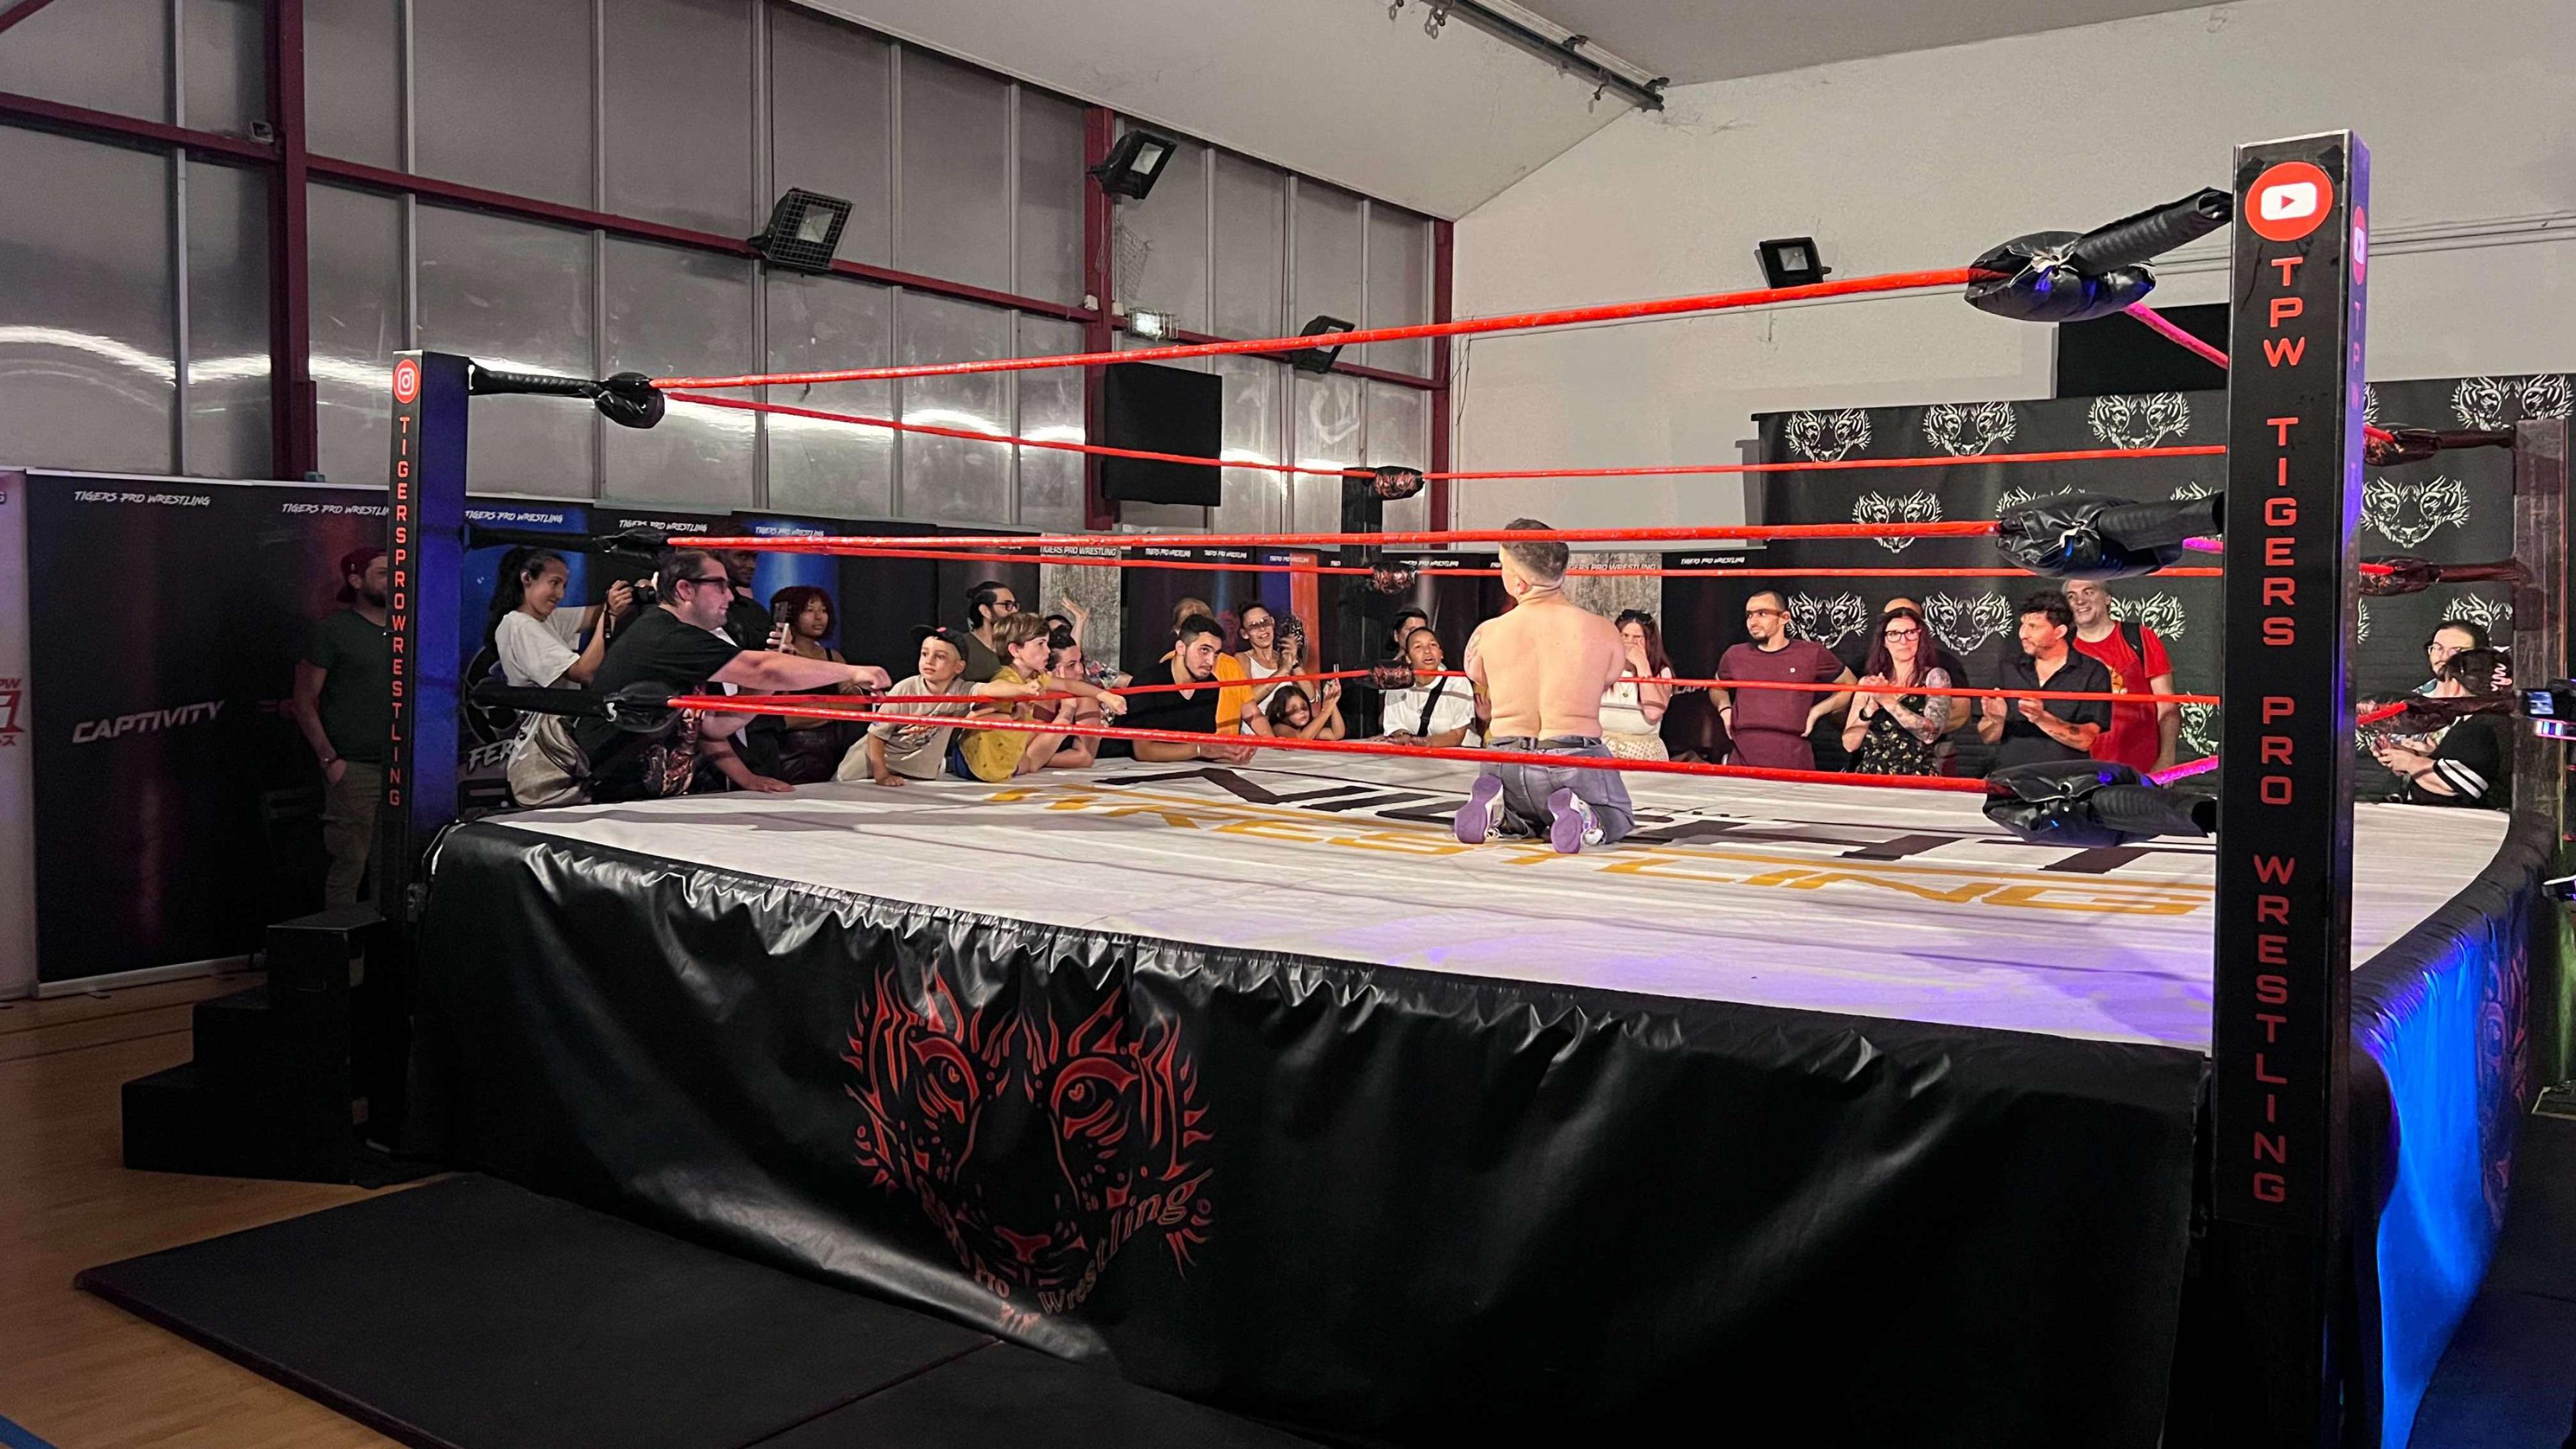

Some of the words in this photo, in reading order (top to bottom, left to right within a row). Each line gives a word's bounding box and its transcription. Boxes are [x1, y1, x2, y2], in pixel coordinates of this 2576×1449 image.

[2263, 256, 2305, 368] TPW
[74, 491, 117, 502] TIGERS
[120, 493, 145, 503] PRO
[148, 494, 211, 506] WRESTLING
[282, 503, 319, 514] TIGERS
[321, 504, 343, 514] PRO
[345, 506, 389, 516] WRESTLI
[517, 513, 564, 523] WRESTLING
[2263, 417, 2299, 647] TIGERS
[72, 700, 225, 743] CAPTIVITY
[2261, 696, 2294, 806] PRO
[2253, 854, 2296, 1203] WRESTLING
